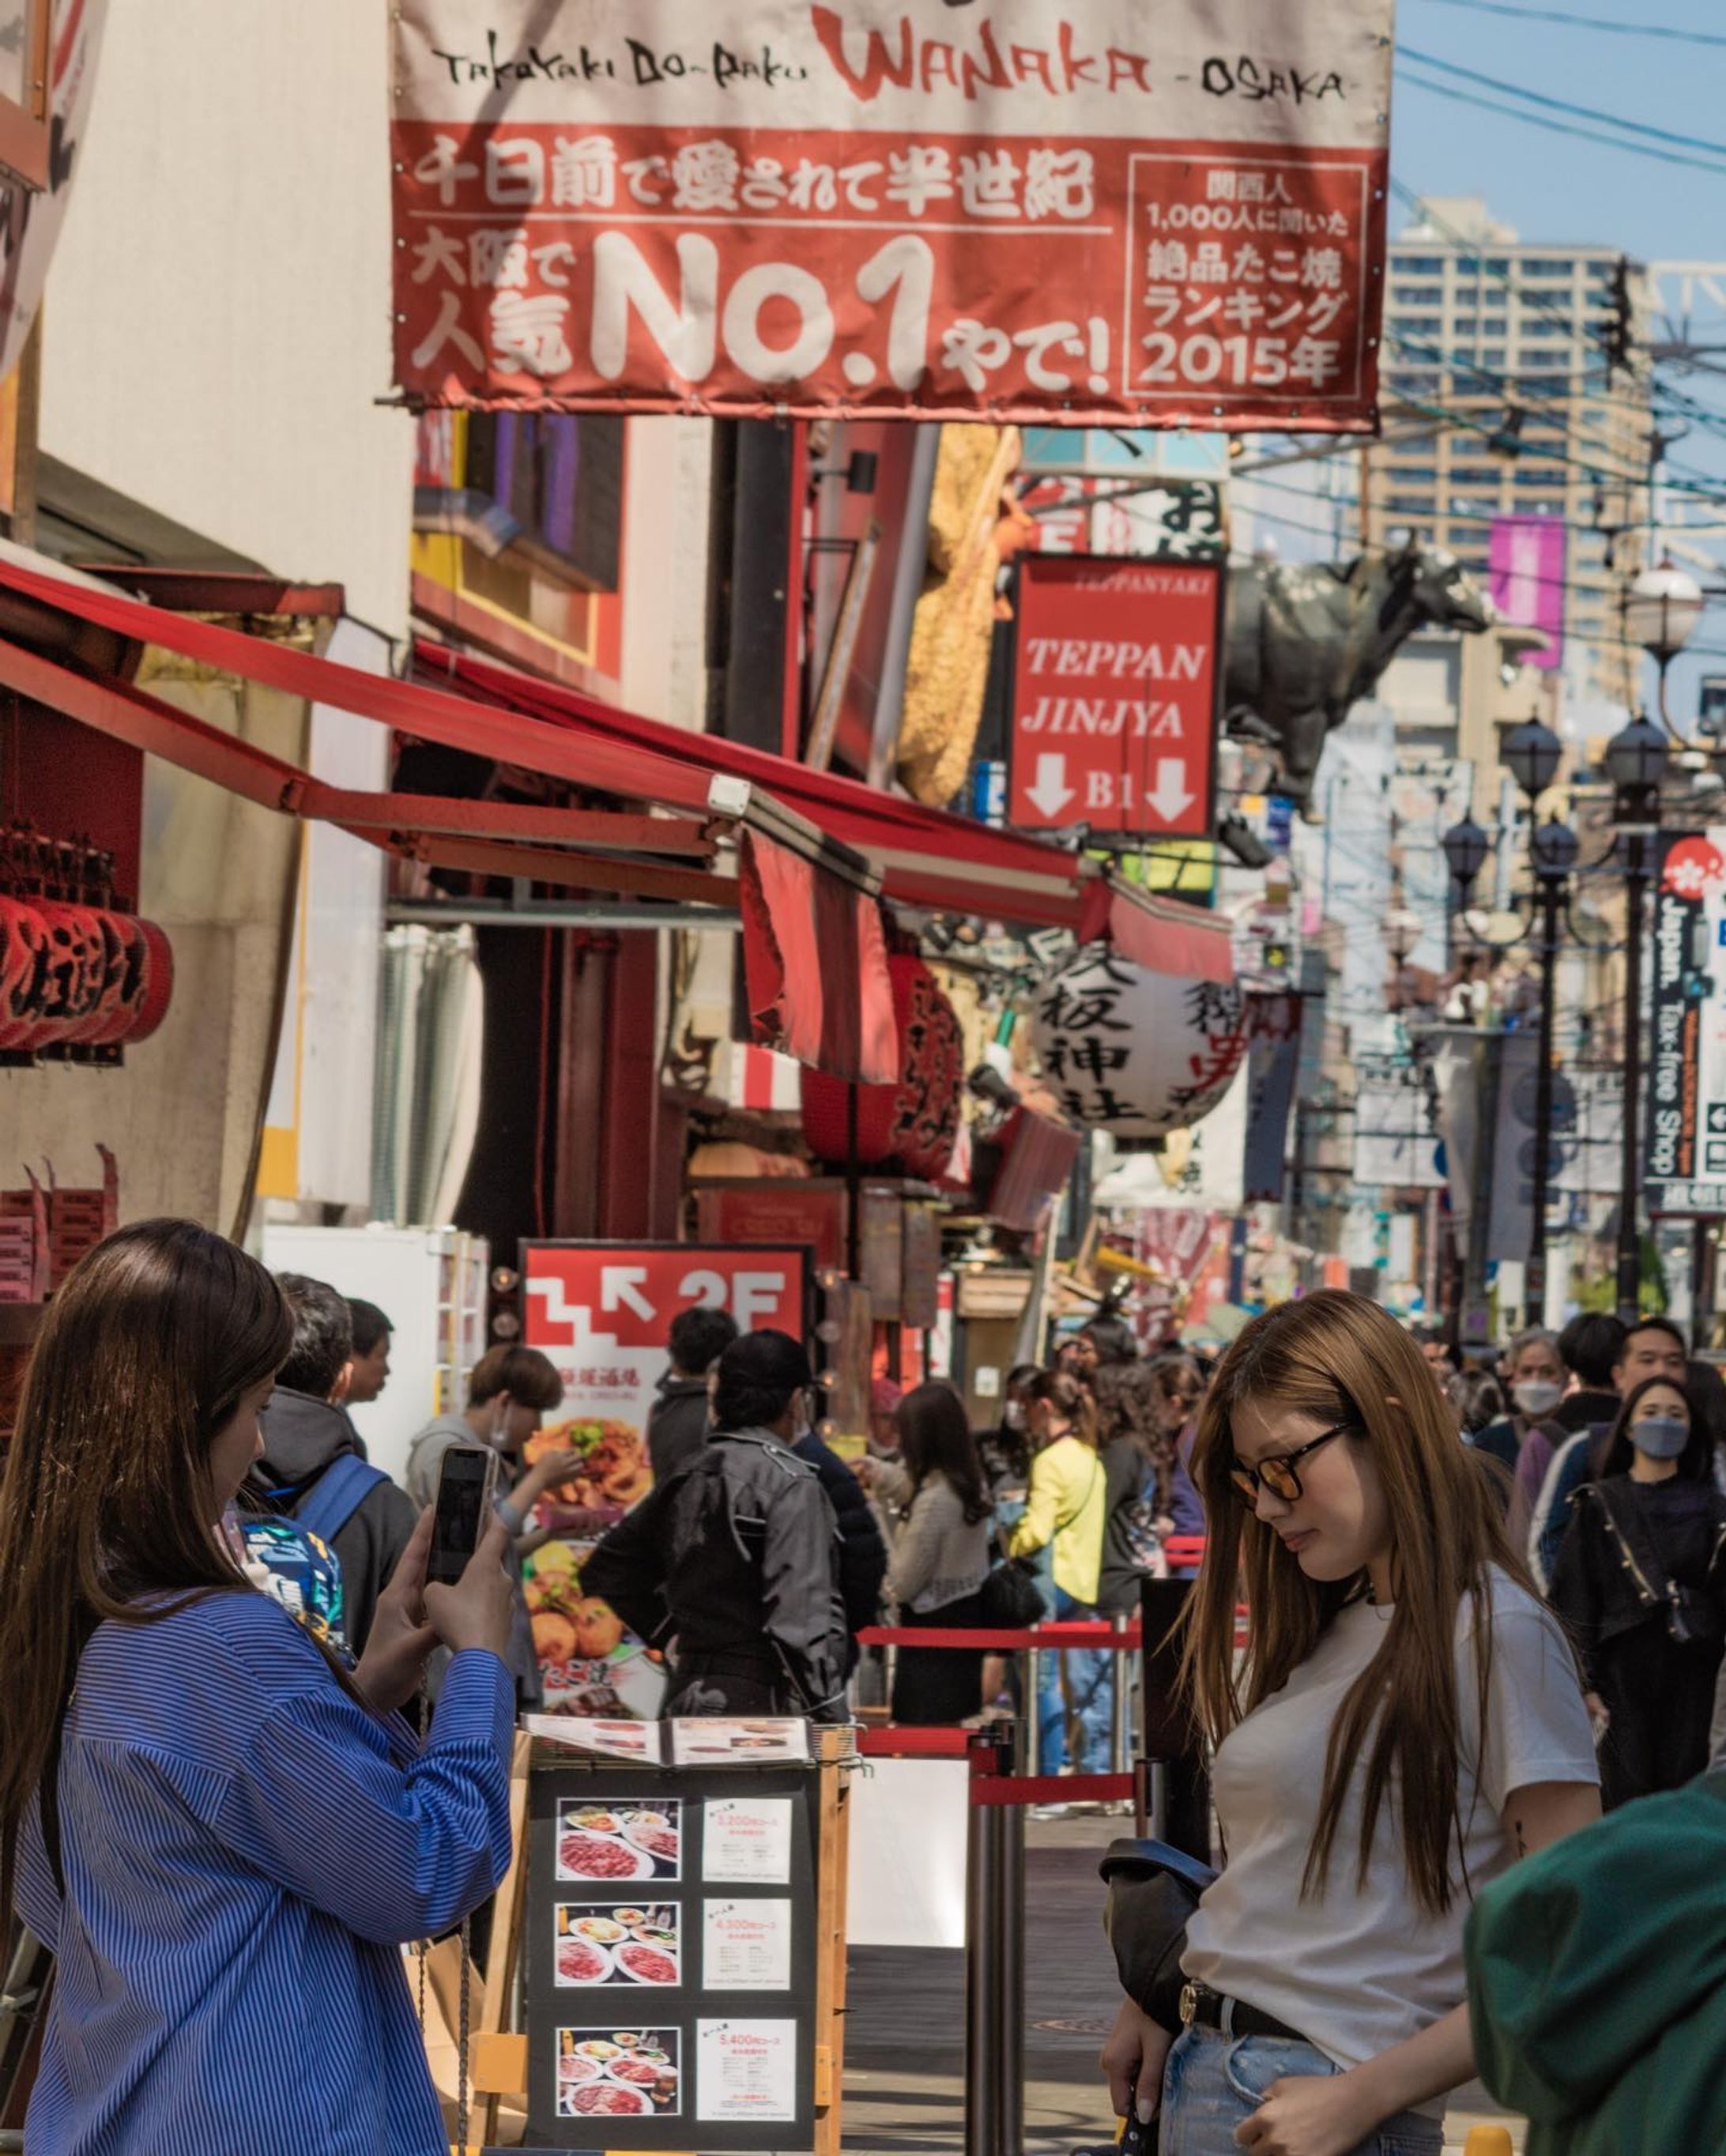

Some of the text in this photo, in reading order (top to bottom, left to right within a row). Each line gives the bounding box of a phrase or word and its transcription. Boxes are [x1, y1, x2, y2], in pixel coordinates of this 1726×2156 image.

[413, 134, 1095, 220] 千日前で愛されて半世紀
[1206, 169, 1293, 204] 関西人
[1147, 202, 1349, 237] 1,000人に聞いた
[410, 224, 576, 289] 大阪で
[1148, 238, 1343, 289] 絶品たこ焼
[1143, 285, 1350, 335] ランキング
[1138, 330, 1342, 389] 2015年
[1027, 638, 1208, 681] TEPPAN
[1020, 695, 1184, 739] JINJYA
[1086, 769, 1136, 811] B1
[1654, 1000, 1686, 1102] Tax-free
[1649, 1110, 1683, 1176] Shop
